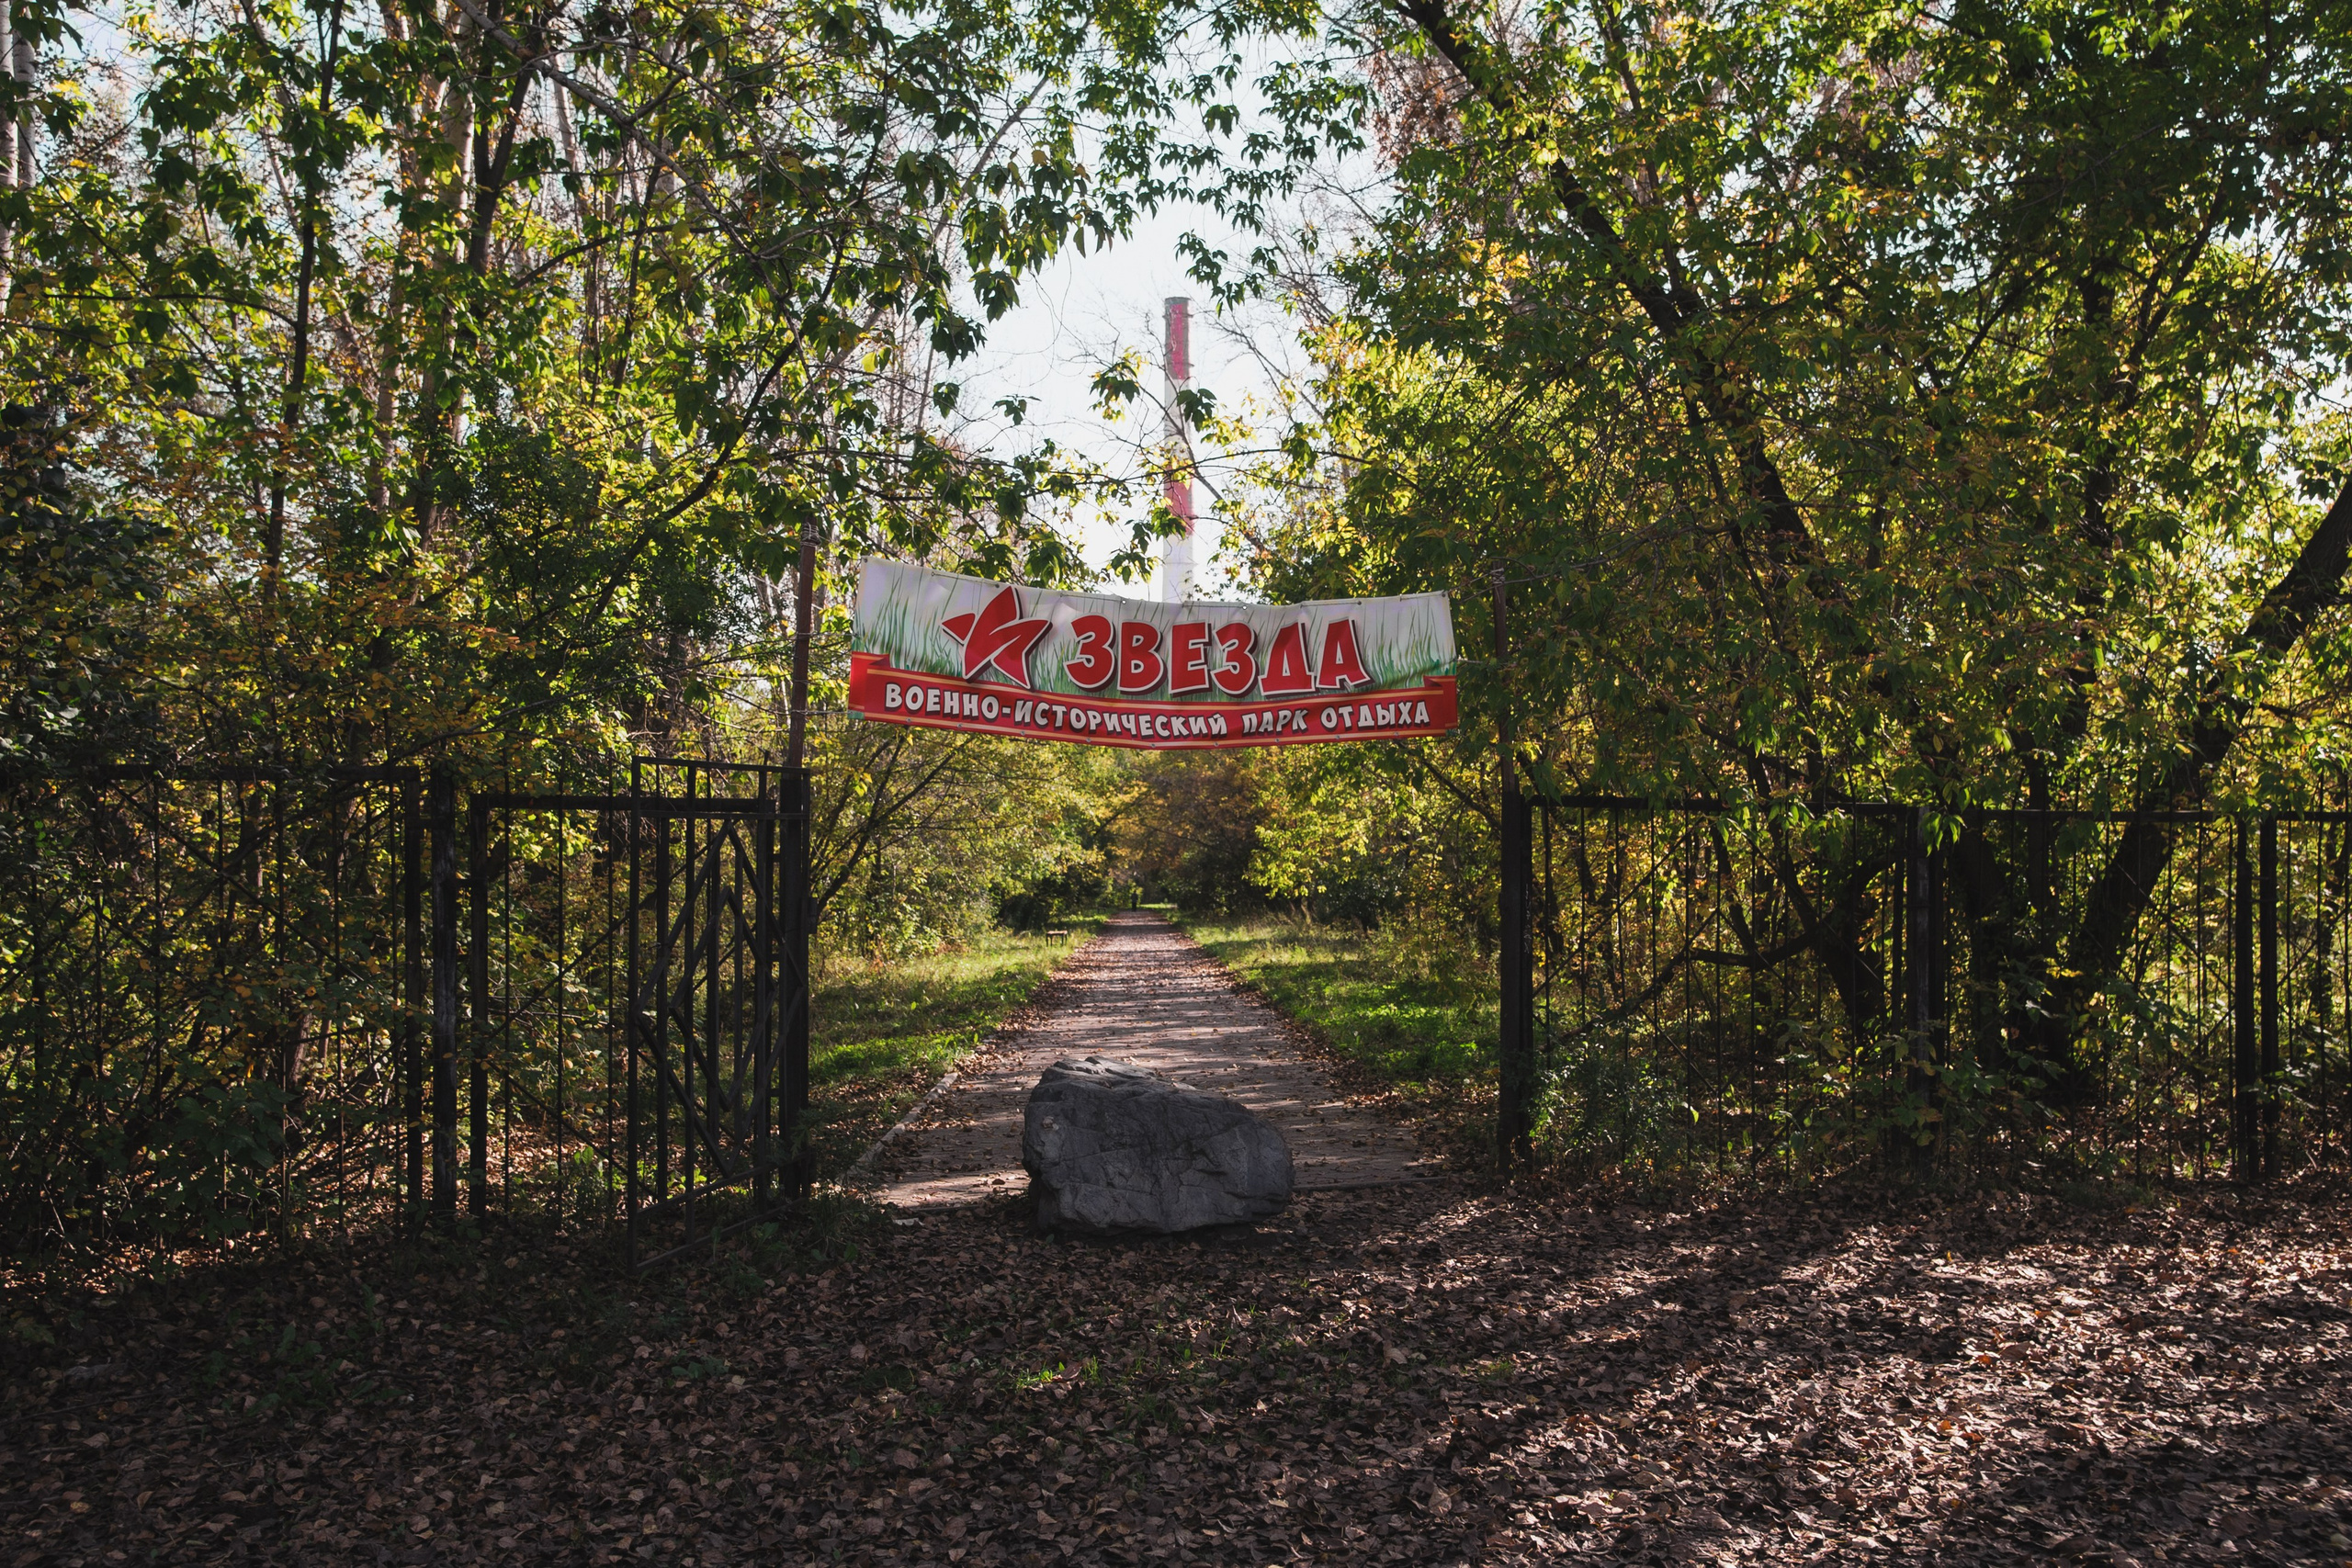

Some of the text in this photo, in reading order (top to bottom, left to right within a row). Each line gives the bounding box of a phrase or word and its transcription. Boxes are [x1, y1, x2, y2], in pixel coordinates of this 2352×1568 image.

[1065, 614, 1372, 696] ЗВЕЗДА
[885, 683, 1430, 738] ВОЕННО-ИСТОРИЧЕСКИЙ ПАРК ОТДЫХА
